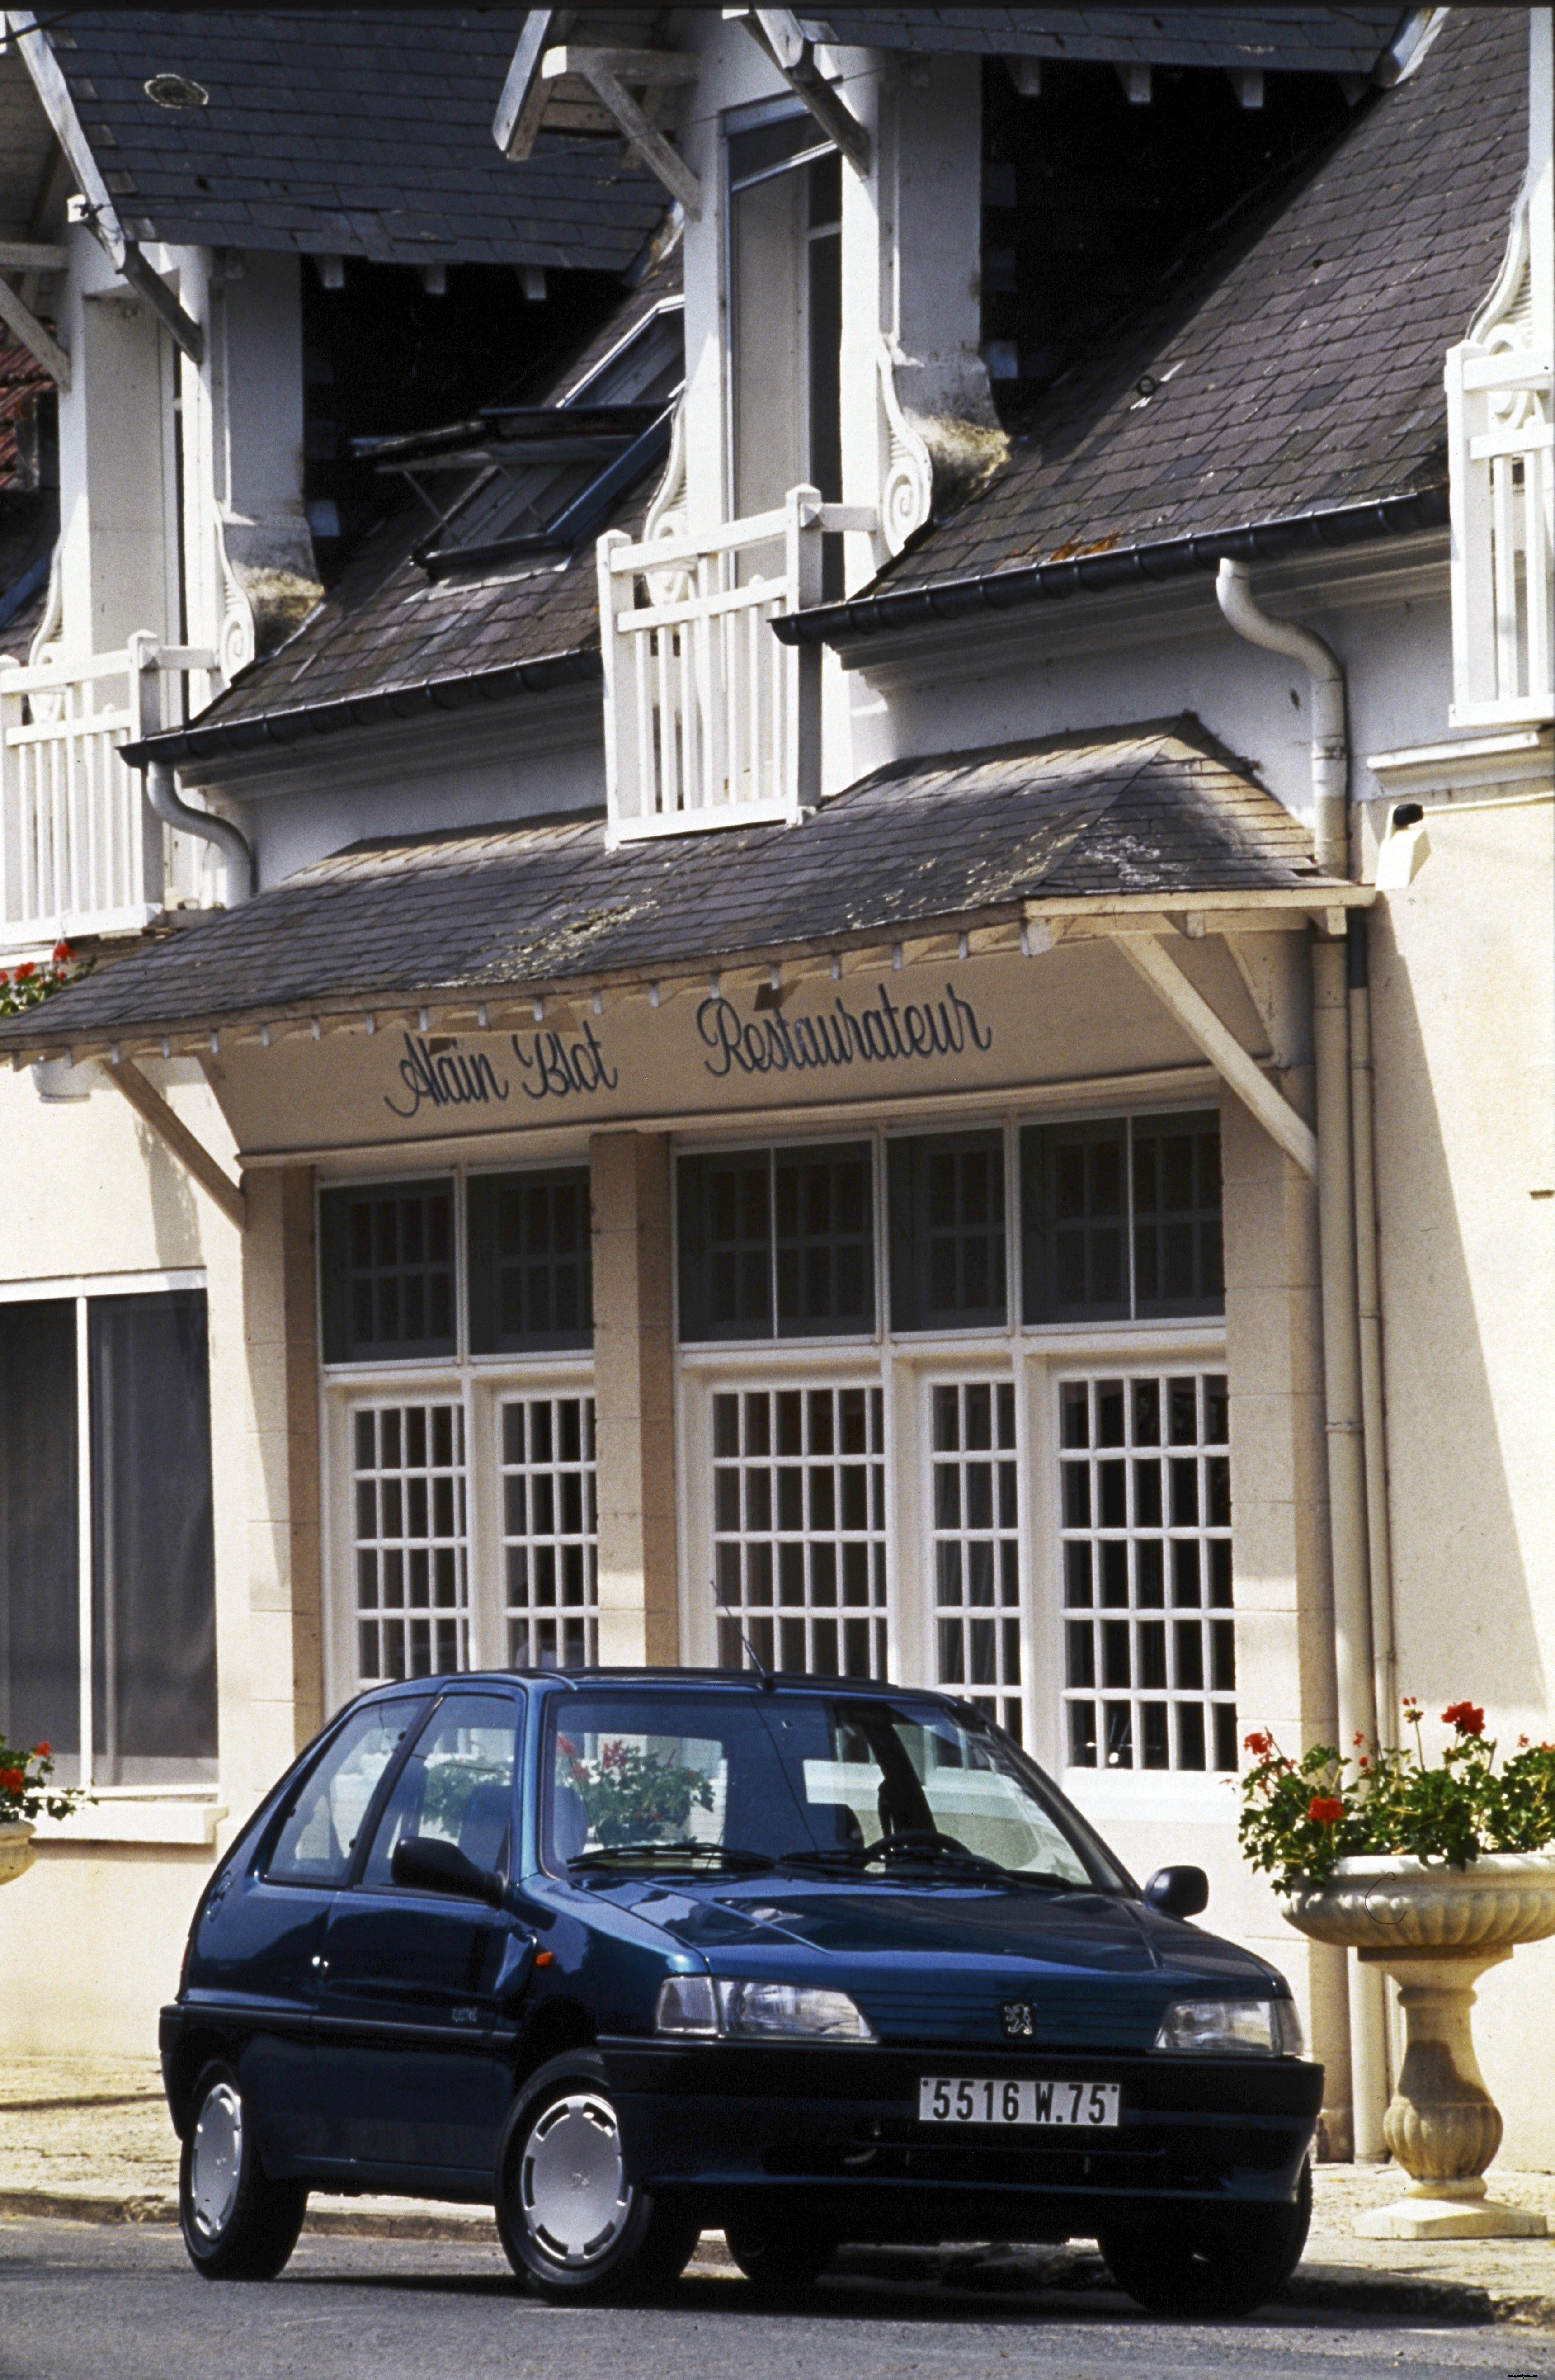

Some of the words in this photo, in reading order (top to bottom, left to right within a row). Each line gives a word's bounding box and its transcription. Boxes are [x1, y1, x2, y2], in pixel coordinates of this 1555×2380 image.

[384, 1031, 509, 1118] Alain
[512, 1020, 618, 1100] Blot
[696, 982, 992, 1077] Restaurateur
[932, 2080, 1020, 2122] 5516
